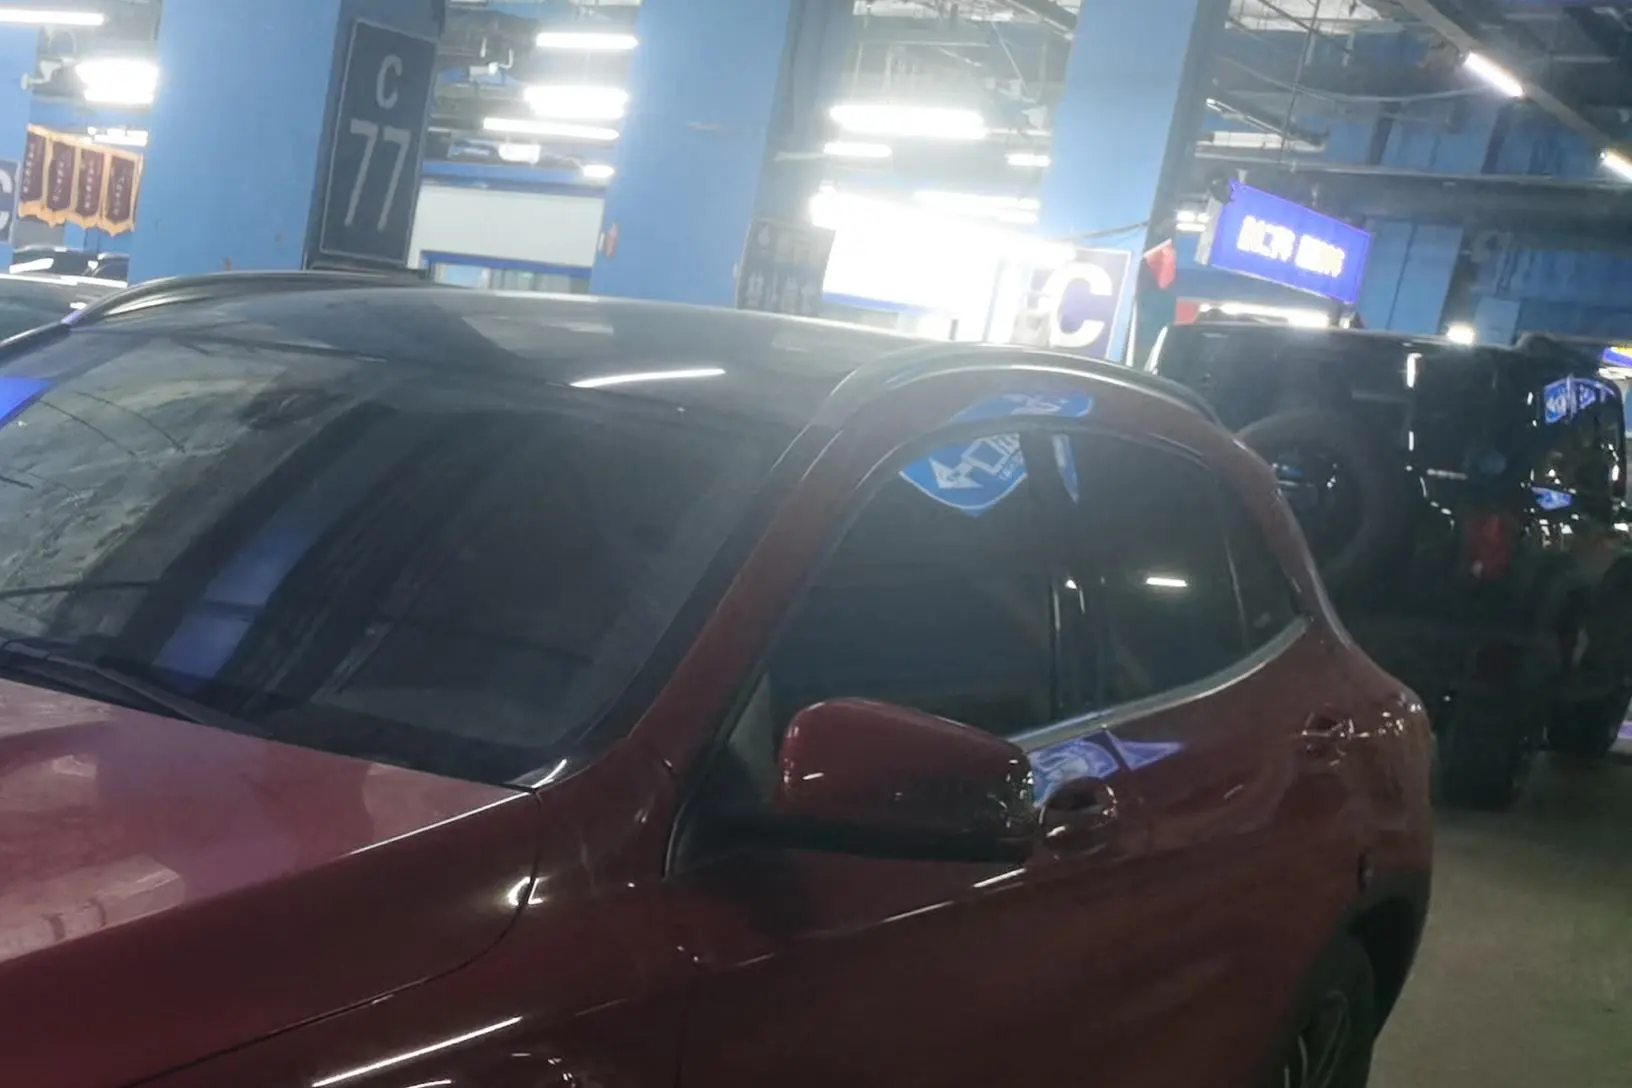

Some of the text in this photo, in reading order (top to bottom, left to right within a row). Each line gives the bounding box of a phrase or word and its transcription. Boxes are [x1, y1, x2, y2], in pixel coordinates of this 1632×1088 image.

[376, 54, 403, 110] C
[344, 118, 411, 234] 77
[1041, 261, 1113, 348] C
